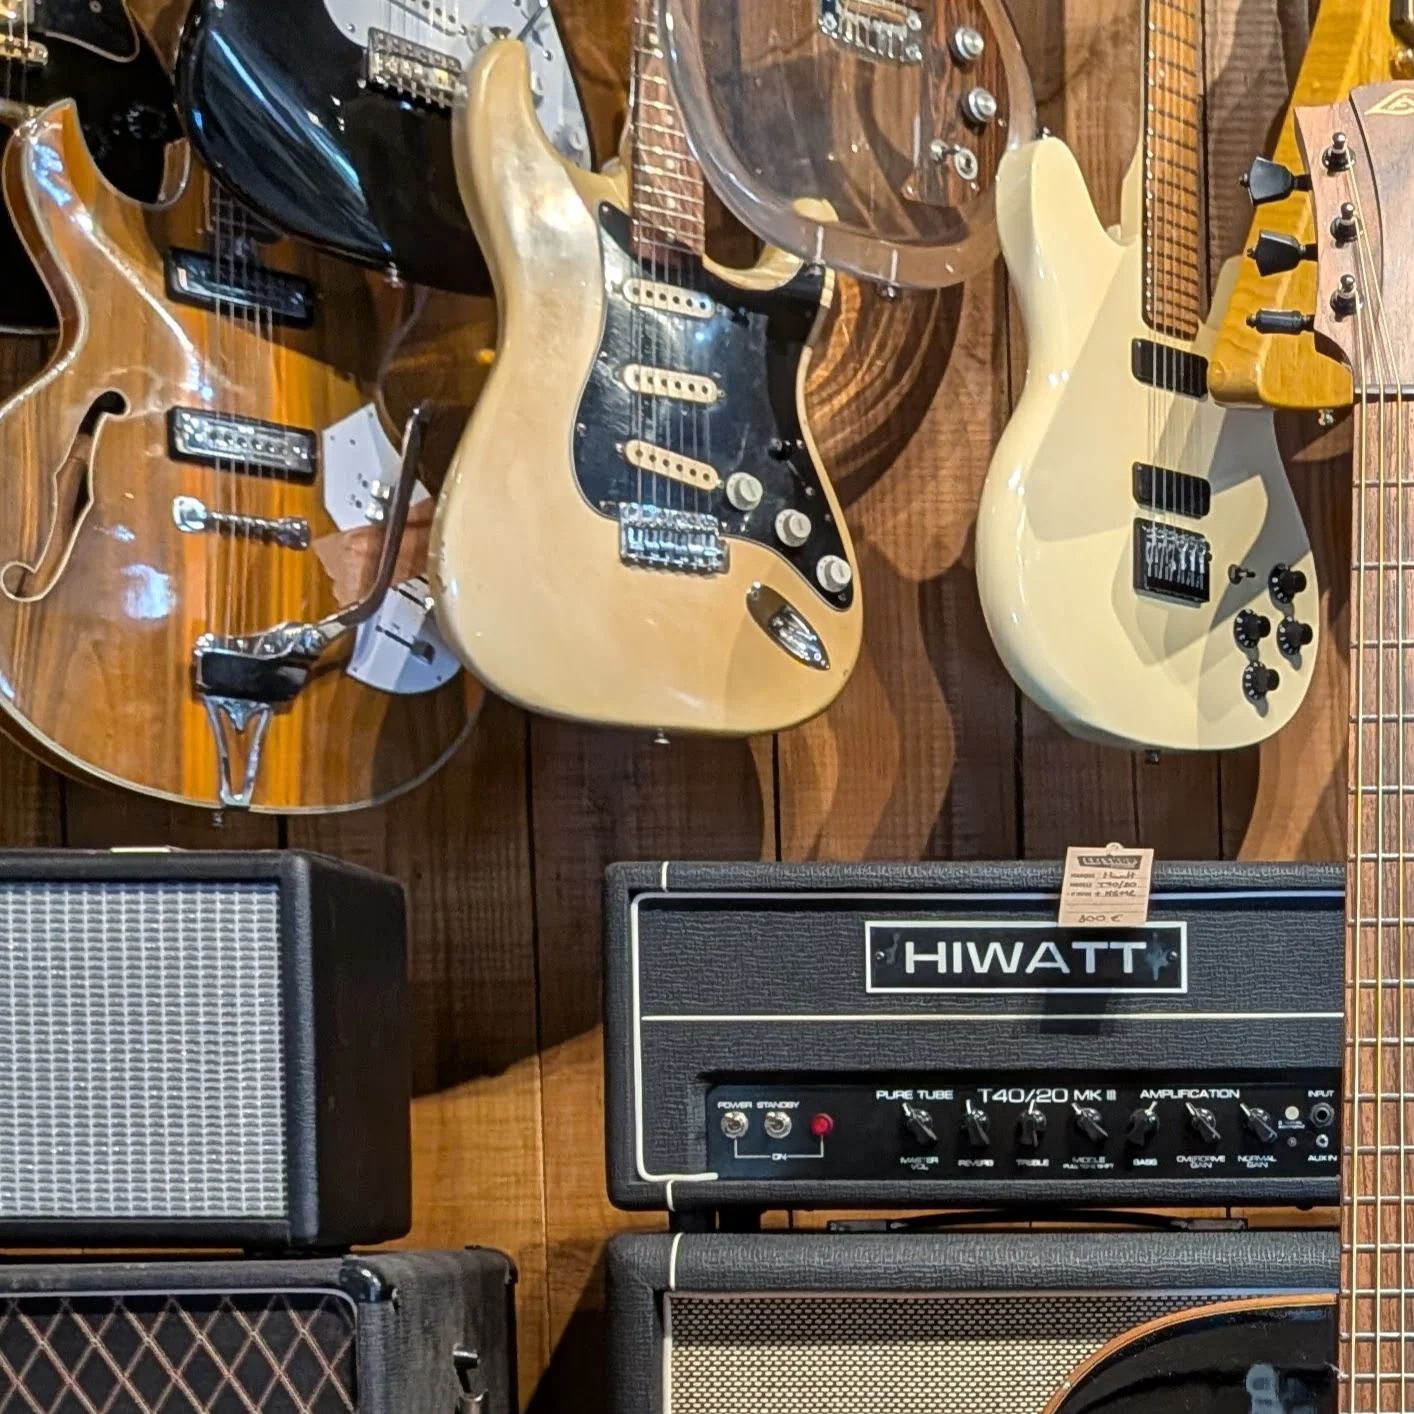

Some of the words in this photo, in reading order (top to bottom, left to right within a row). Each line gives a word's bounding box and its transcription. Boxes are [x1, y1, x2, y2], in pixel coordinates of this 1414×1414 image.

[904, 941, 1148, 974] HIWATT
[875, 1089, 914, 1101] PURE
[916, 1089, 954, 1100] TUBE
[976, 1087, 1070, 1104] T40/20
[1073, 1089, 1103, 1101] MK
[1140, 1088, 1241, 1099] AMPLIFICATION
[1307, 1089, 1335, 1098] INPUT
[717, 1101, 753, 1109] POWER
[756, 1101, 800, 1109] STANDBY
[771, 1153, 788, 1161] ON
[1132, 1158, 1158, 1166] BASS
[1246, 1161, 1269, 1169] GAIN
